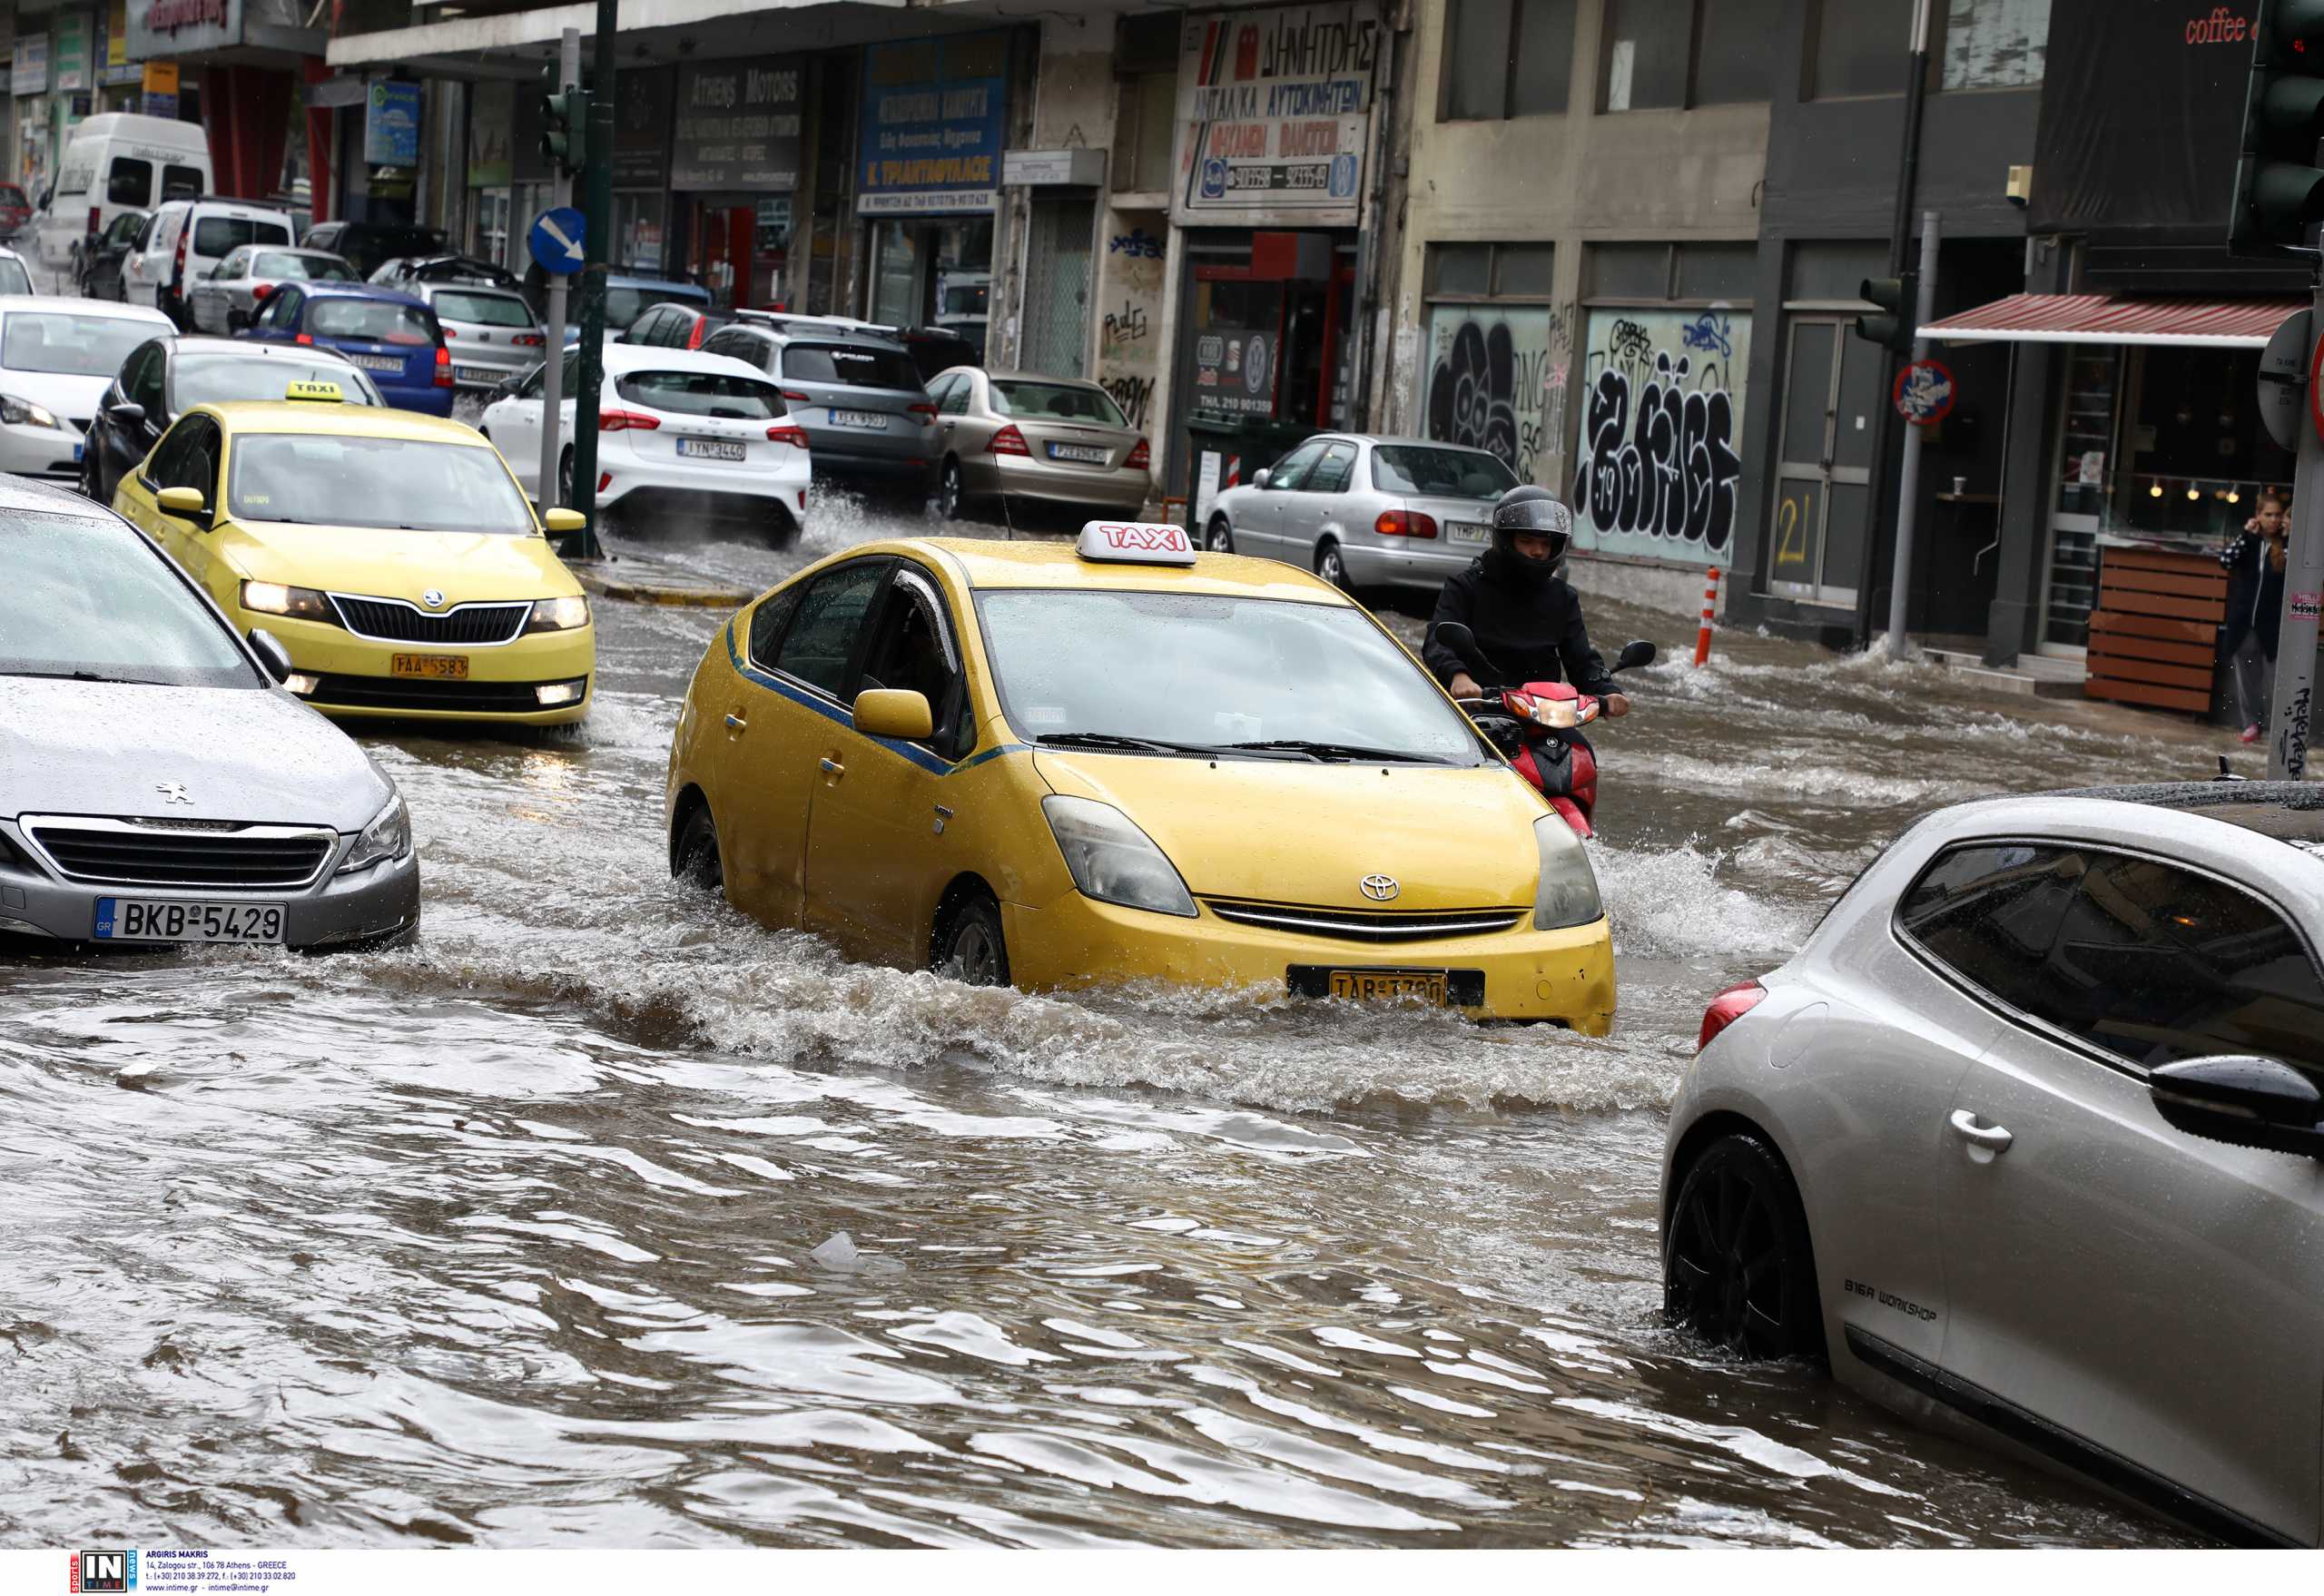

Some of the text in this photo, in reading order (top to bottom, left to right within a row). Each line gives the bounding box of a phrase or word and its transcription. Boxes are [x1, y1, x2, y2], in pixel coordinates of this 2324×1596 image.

[2185, 7, 2246, 44] coffee
[295, 383, 336, 394] TAXI
[1223, 397, 1238, 409] 210
[1240, 399, 1273, 413] 901359
[1099, 526, 1187, 552] TAXI
[96, 921, 112, 931] GR
[1878, 1291, 1937, 1323] WORKSHOP
